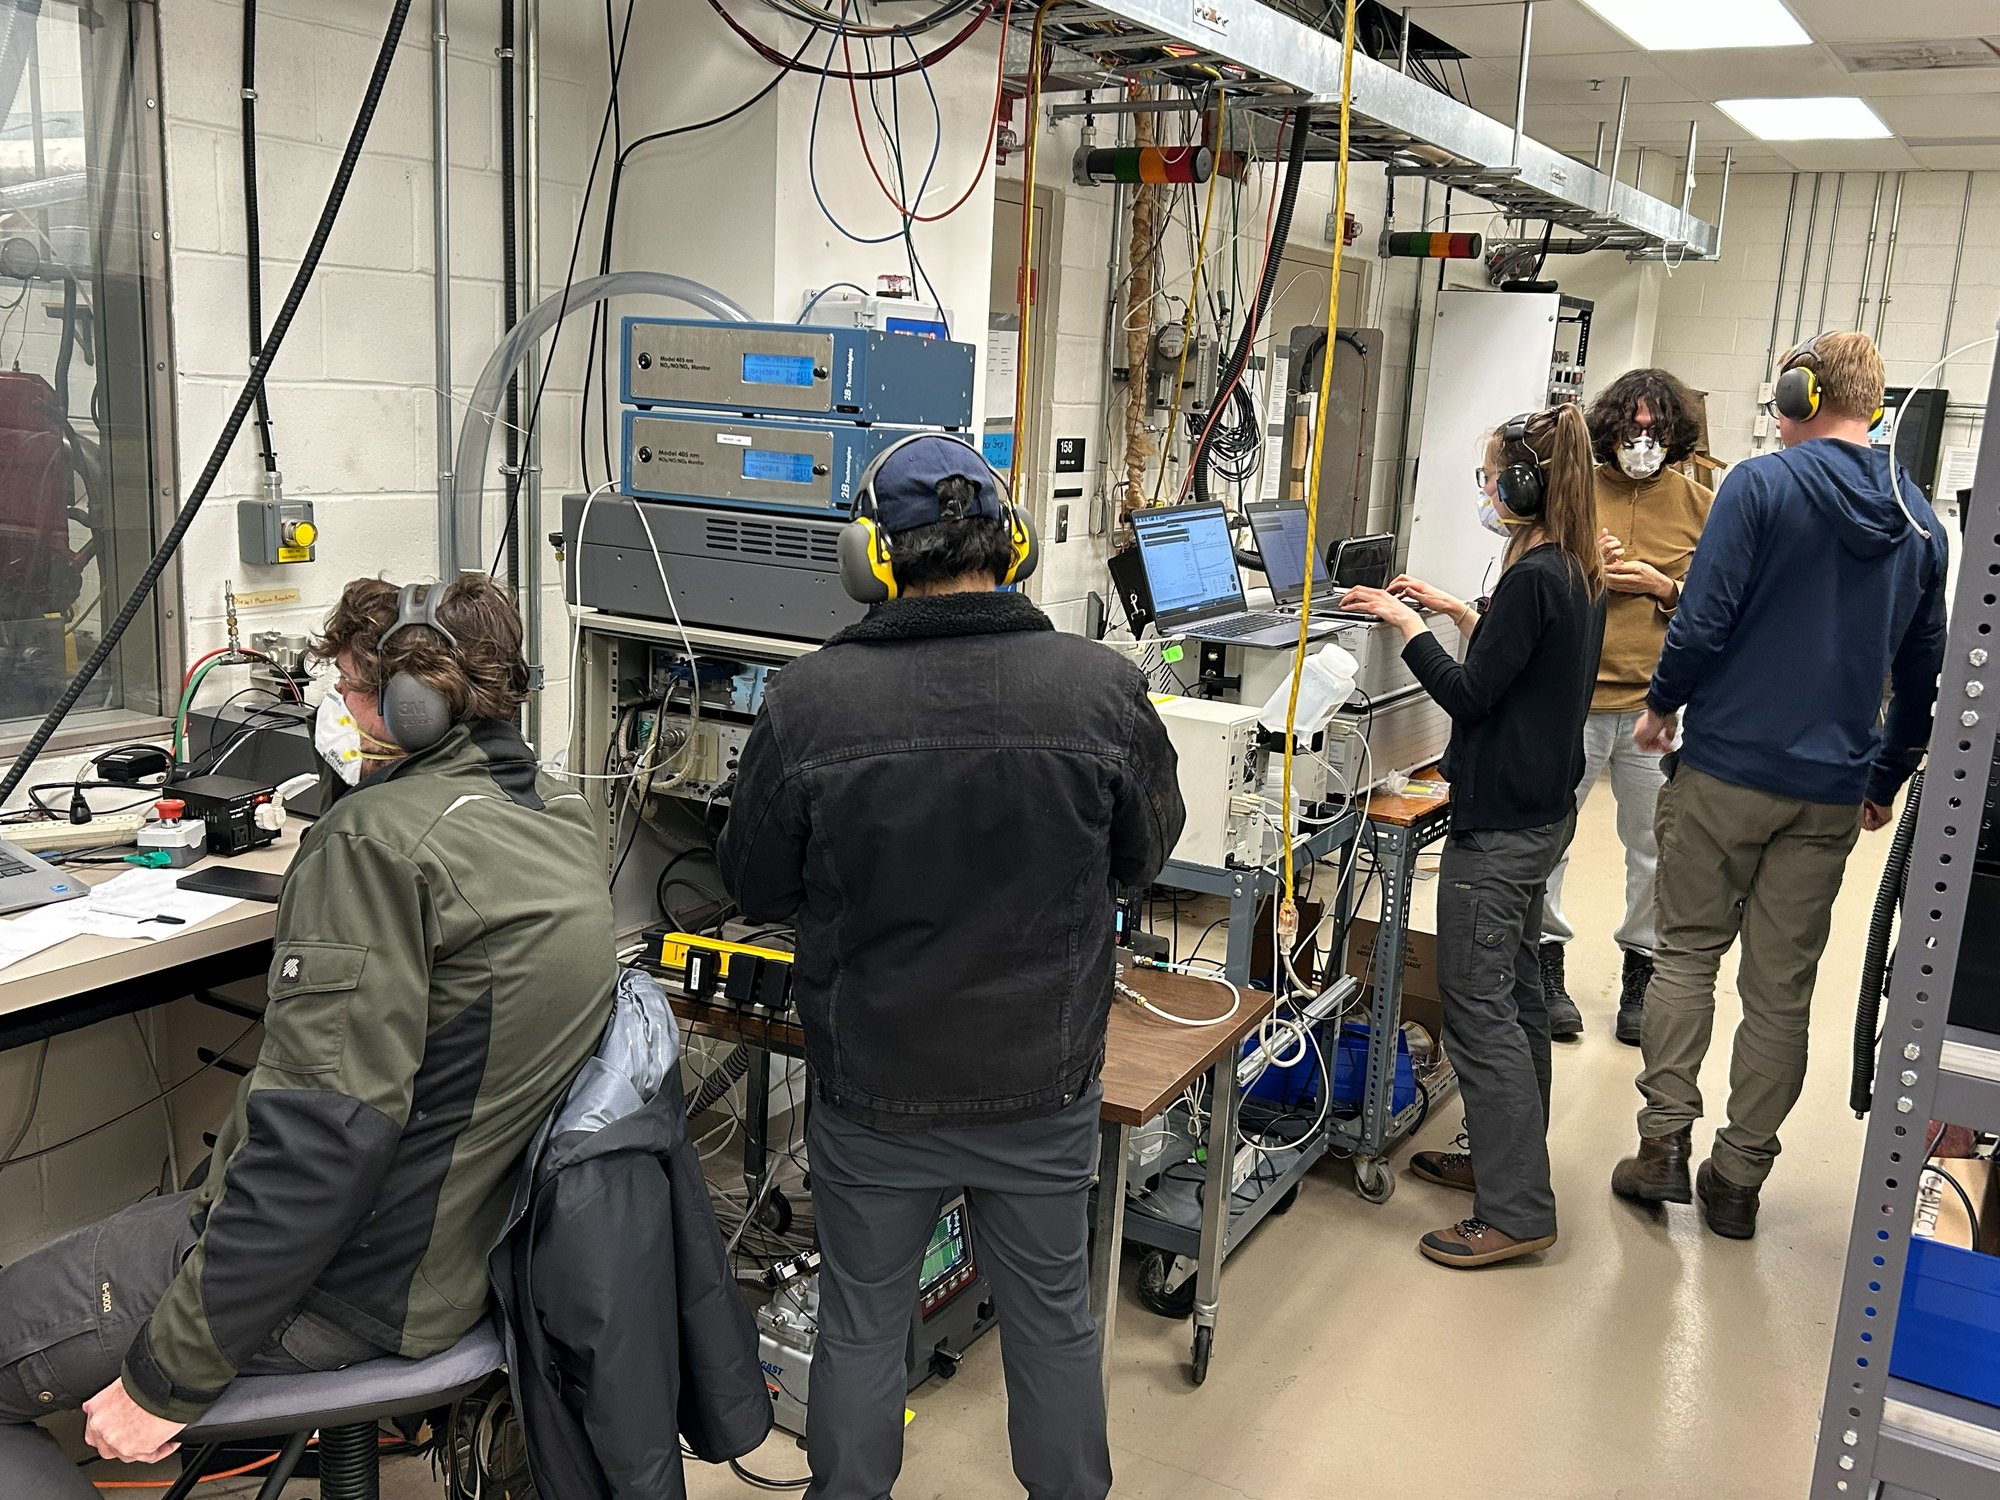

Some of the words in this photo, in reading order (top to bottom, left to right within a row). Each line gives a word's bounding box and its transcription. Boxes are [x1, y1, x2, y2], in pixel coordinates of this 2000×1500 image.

[843, 388, 851, 401] 2B
[1060, 440, 1073, 454] 158
[841, 483, 850, 499] 2B
[761, 1360, 784, 1376] GAST
